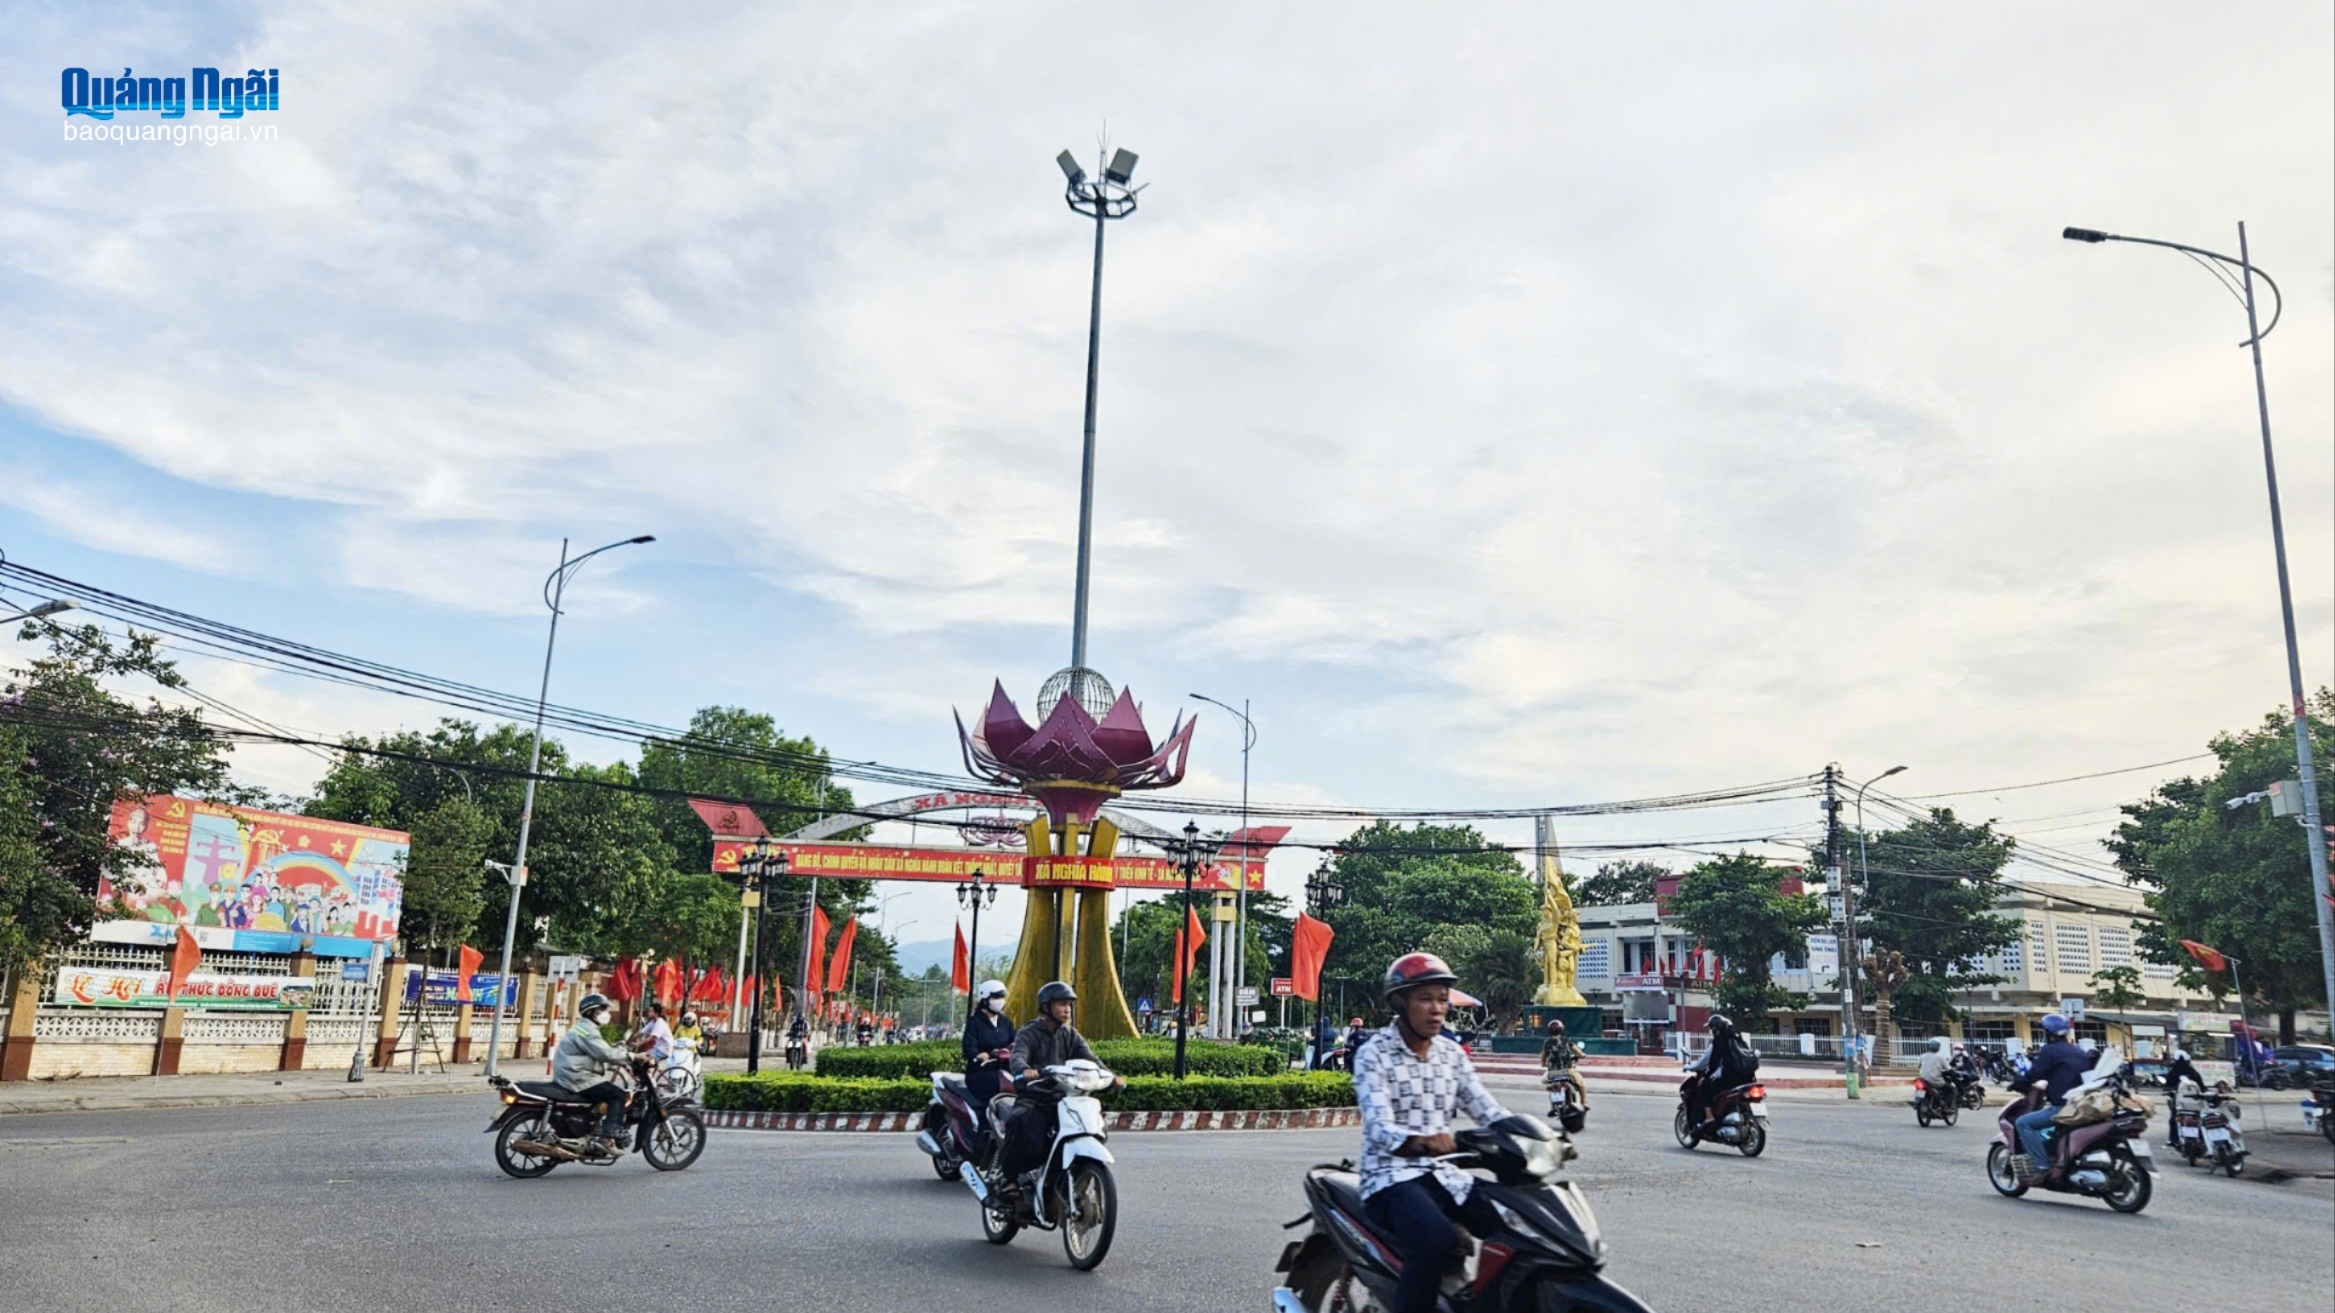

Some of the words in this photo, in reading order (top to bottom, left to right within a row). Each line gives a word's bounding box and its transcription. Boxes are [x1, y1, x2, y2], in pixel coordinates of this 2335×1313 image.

[1036, 860, 1050, 880] XÃ
[1051, 860, 1087, 881] NGHĨA
[1641, 978, 1661, 987] ATM
[1691, 980, 1713, 989] ATM
